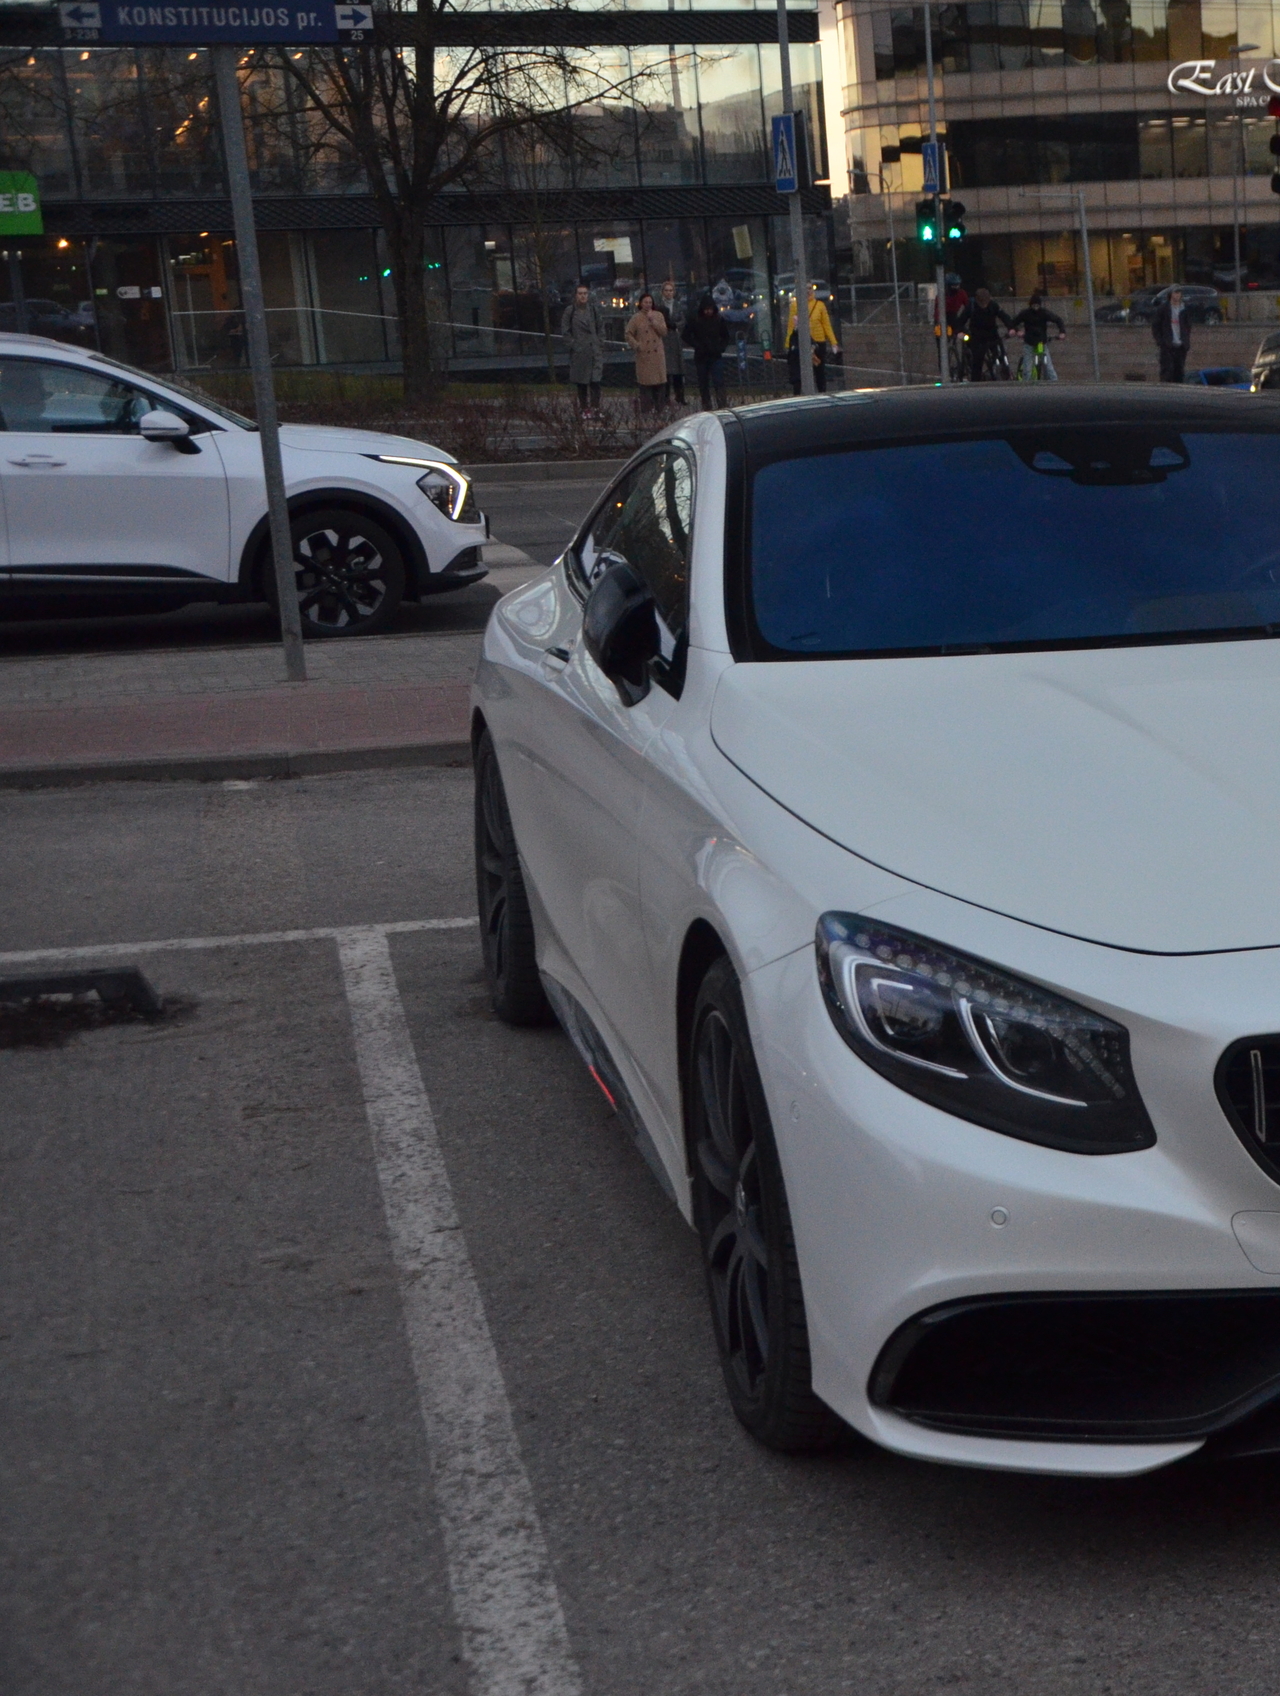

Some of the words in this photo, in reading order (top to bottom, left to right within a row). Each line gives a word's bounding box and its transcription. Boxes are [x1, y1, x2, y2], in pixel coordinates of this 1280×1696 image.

[117, 6, 290, 26] KONSTITUCIJOS
[297, 10, 322, 30] pr.
[351, 30, 365, 41] 25
[1167, 59, 1255, 95] East
[1236, 96, 1258, 108] SPA
